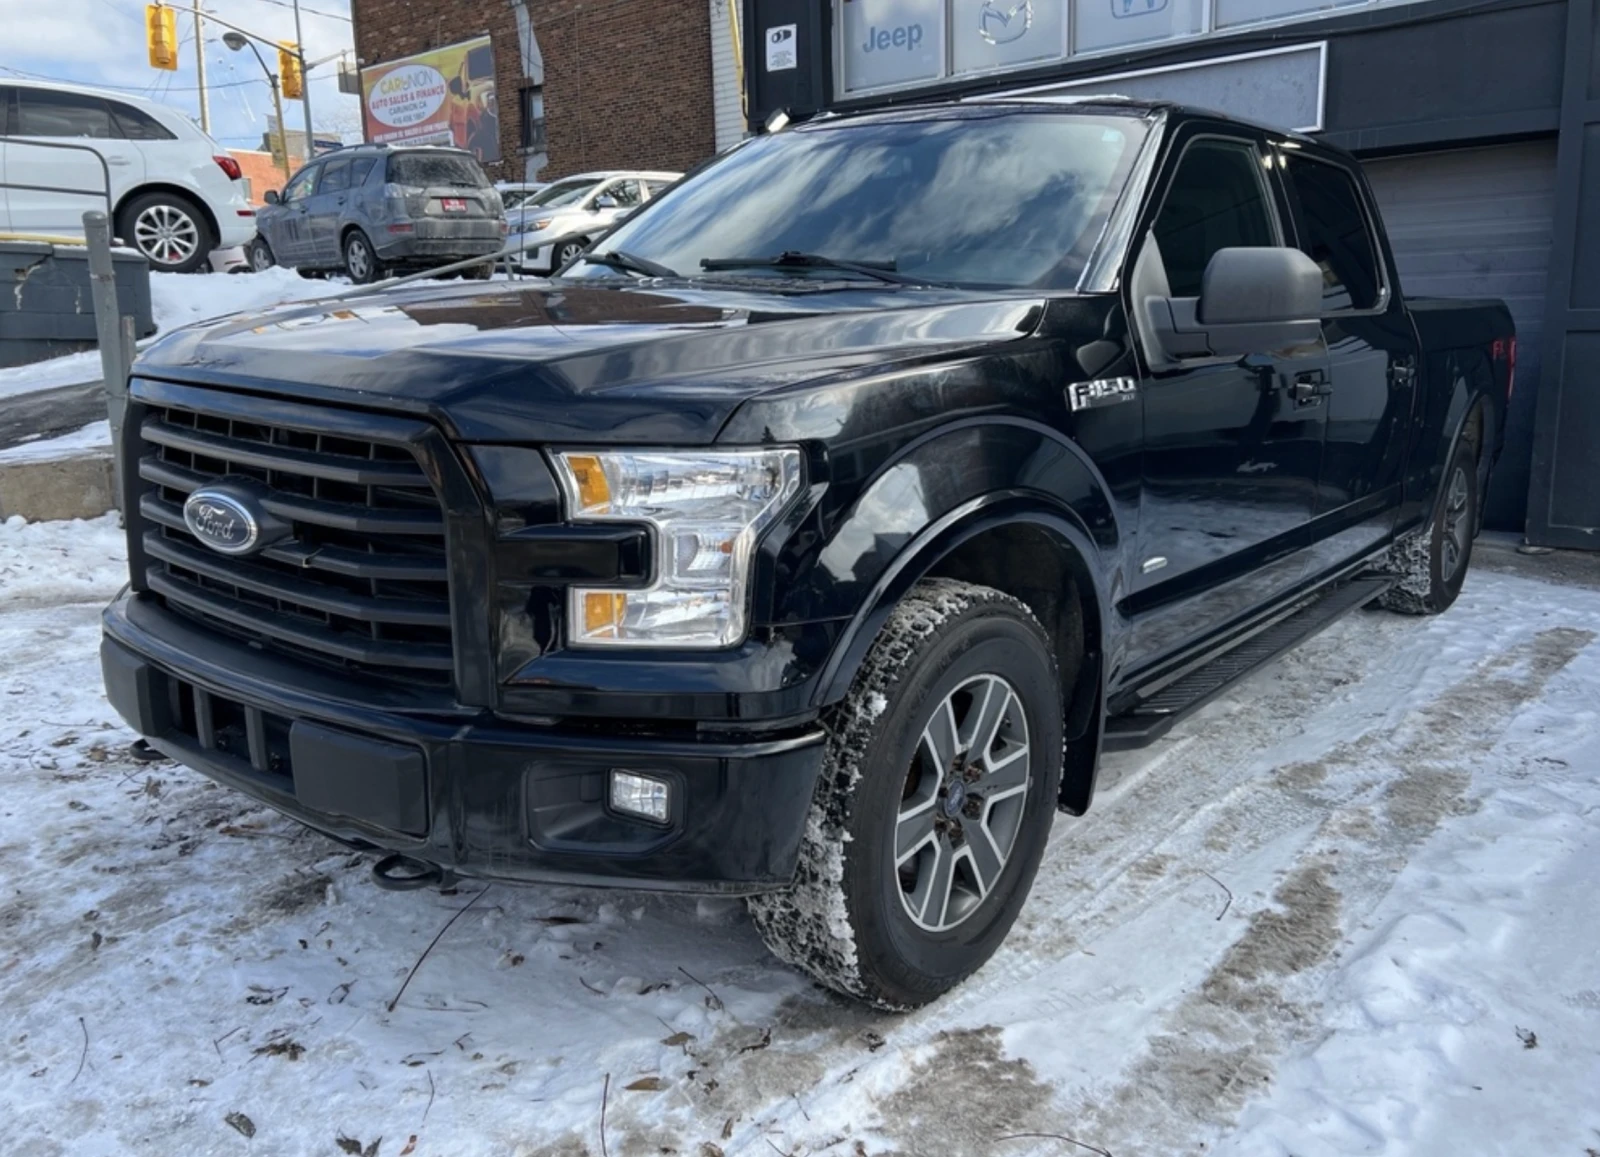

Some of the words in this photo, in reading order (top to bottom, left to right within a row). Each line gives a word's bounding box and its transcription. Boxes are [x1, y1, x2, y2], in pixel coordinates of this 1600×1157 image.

[862, 23, 923, 53] Jeep
[372, 96, 388, 109] AUTO
[389, 93, 409, 107] SALES
[416, 84, 445, 100] FINANCE
[195, 504, 235, 540] Ford
